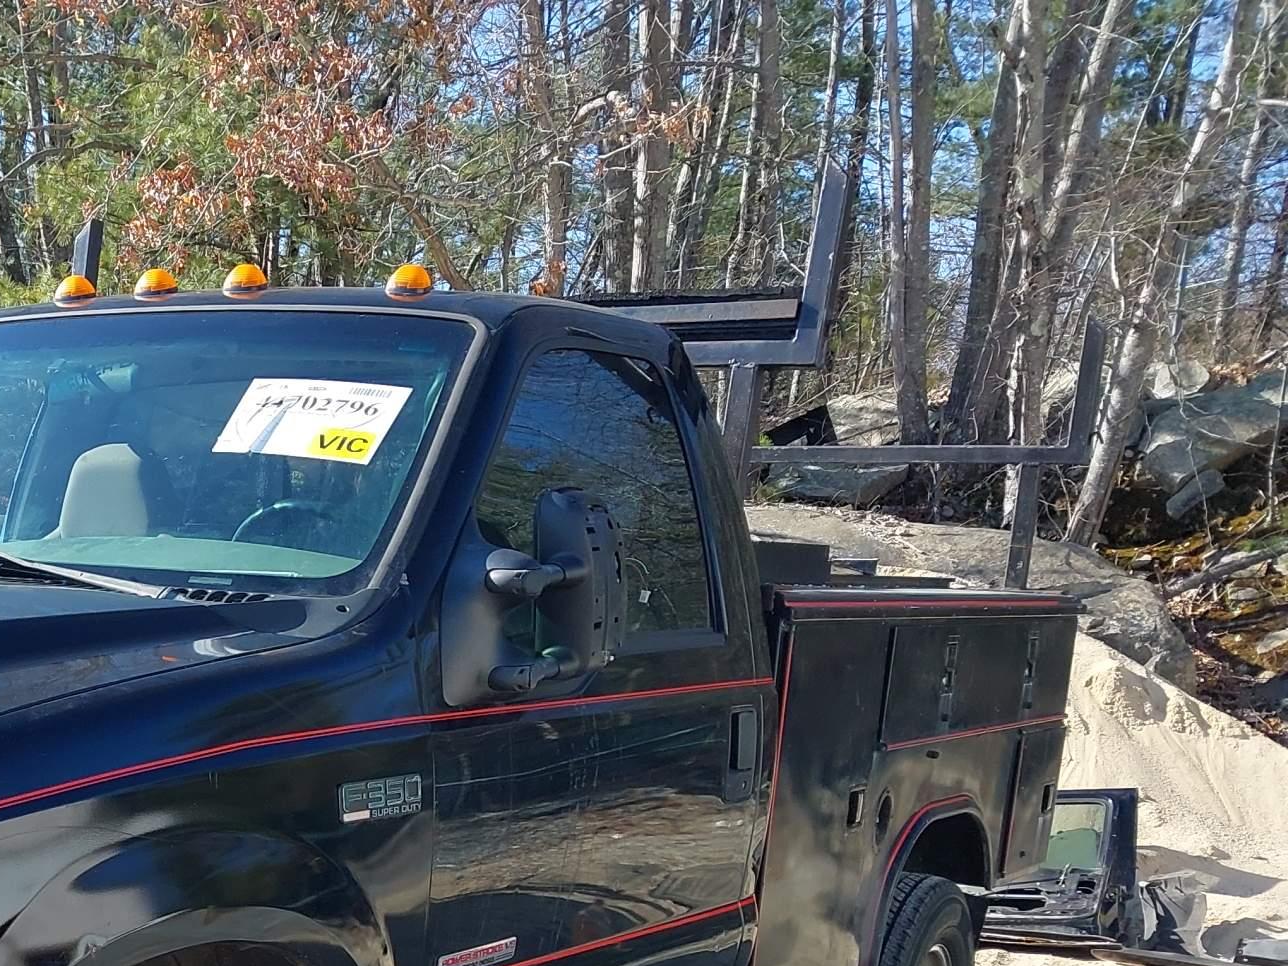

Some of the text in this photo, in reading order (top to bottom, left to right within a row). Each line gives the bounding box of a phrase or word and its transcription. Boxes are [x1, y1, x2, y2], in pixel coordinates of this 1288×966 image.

[318, 433, 369, 453] VIC
[371, 802, 422, 818] SUPER DUTY
